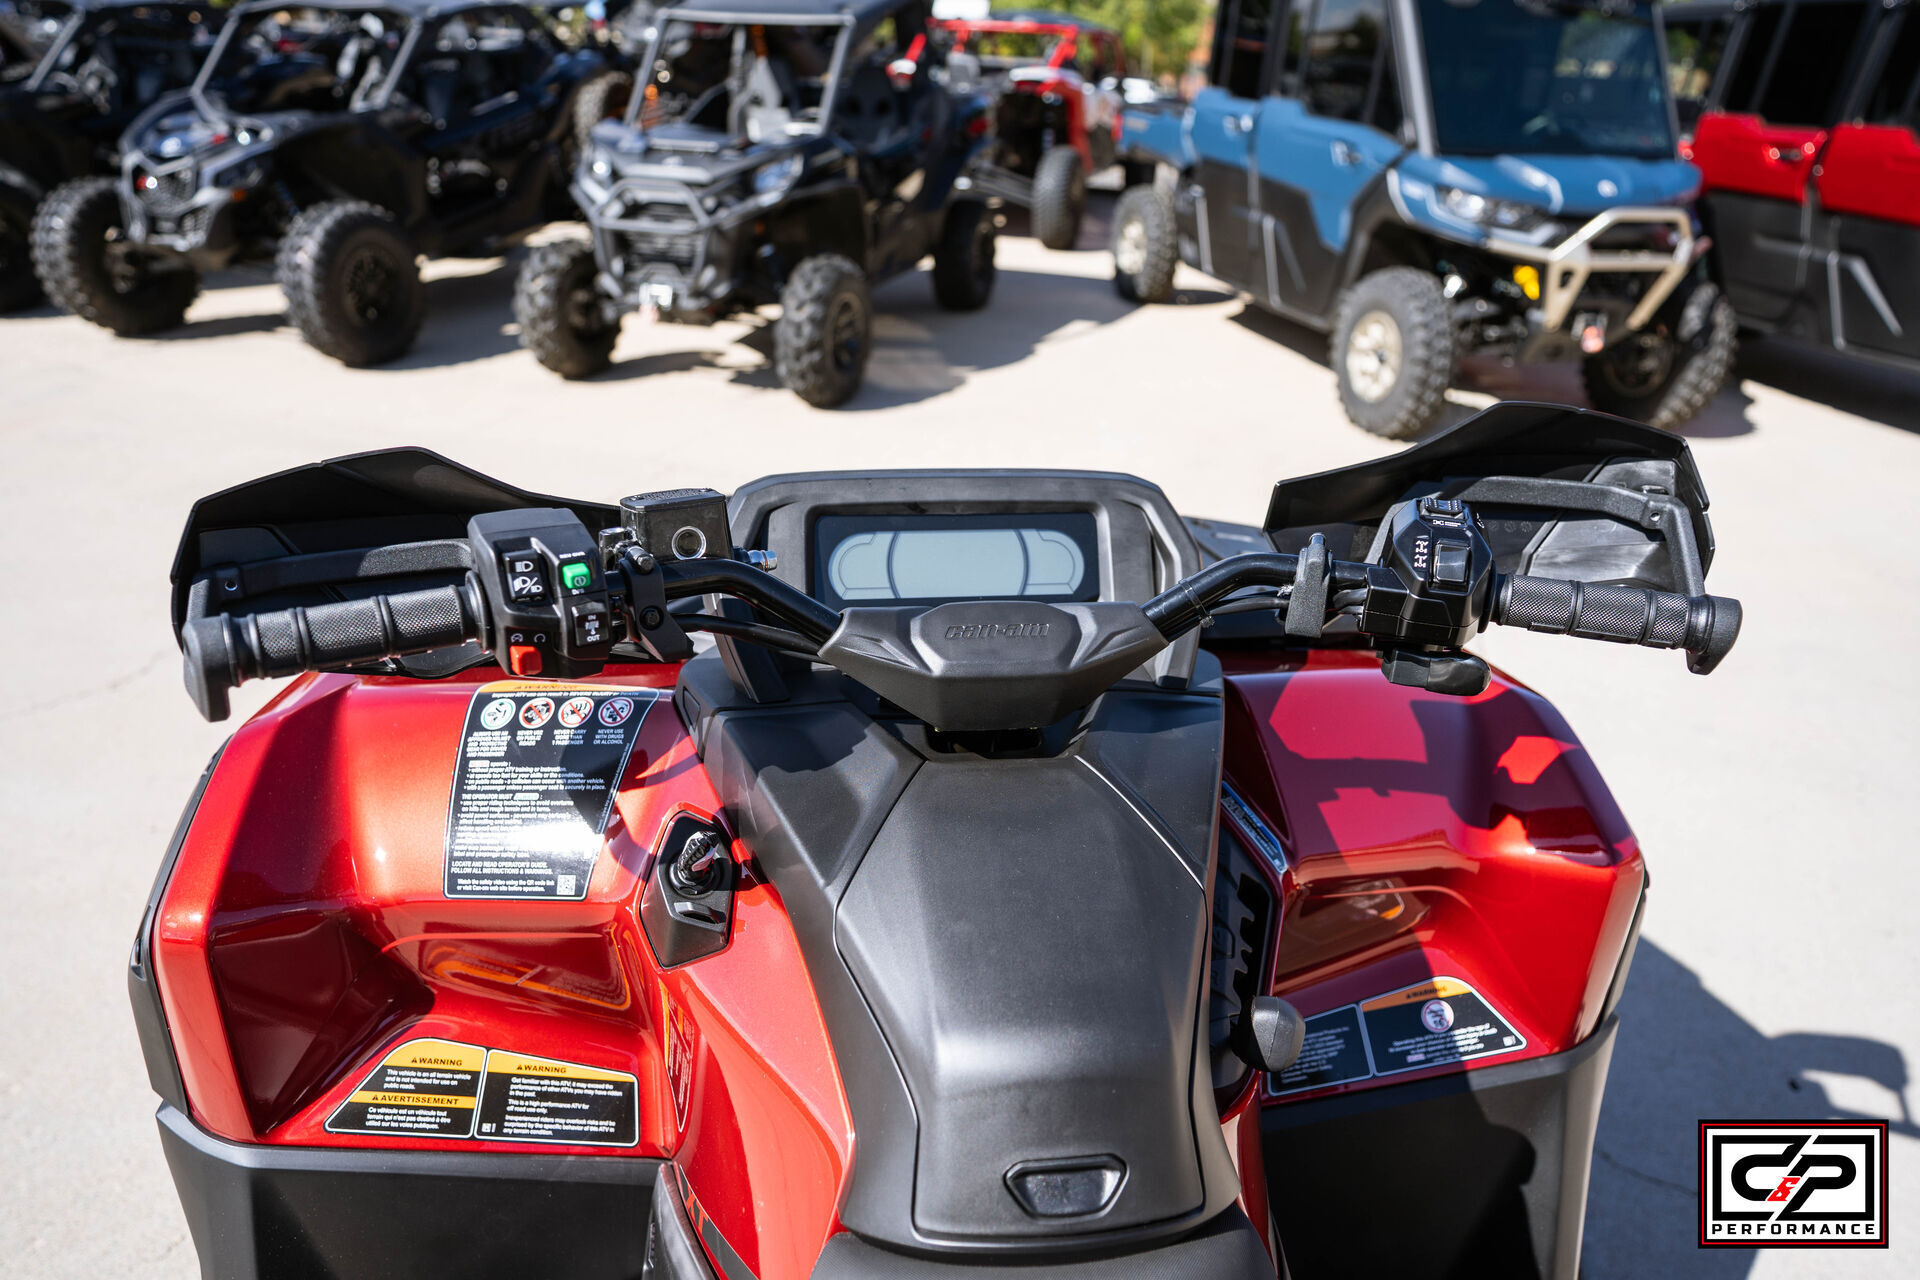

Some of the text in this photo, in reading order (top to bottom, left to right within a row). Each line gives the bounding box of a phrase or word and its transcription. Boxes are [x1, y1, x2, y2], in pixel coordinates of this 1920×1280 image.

[945, 624, 1049, 640] can-am
[419, 1058, 462, 1066] WARNING
[524, 1065, 566, 1073] WARNING
[380, 1095, 459, 1105] AVERTISSEMENT
